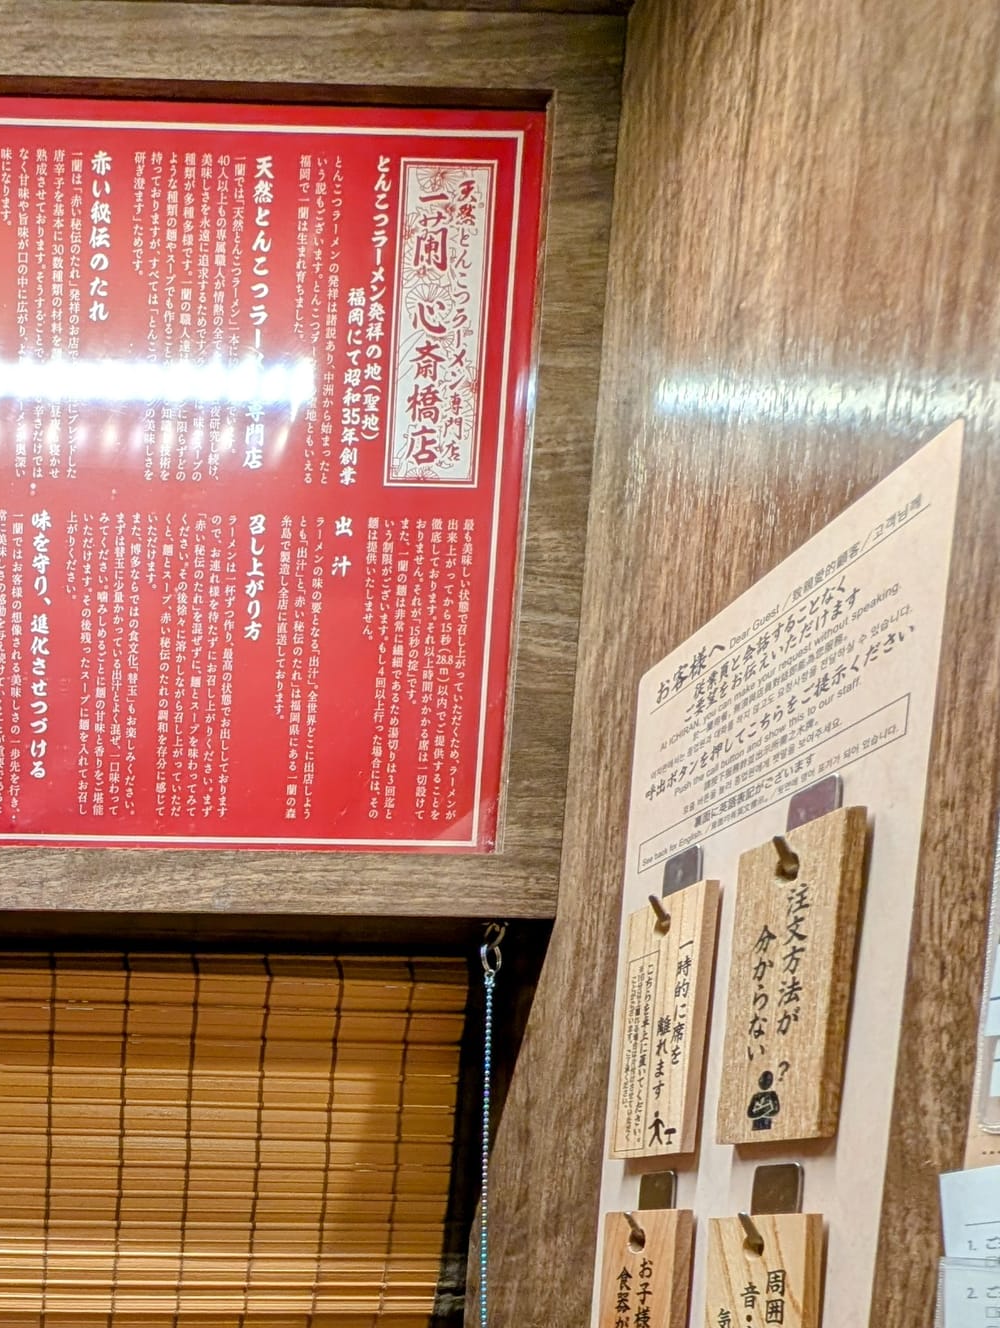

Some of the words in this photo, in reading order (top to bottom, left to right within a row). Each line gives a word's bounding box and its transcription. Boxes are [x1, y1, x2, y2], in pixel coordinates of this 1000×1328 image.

[0, 148, 13, 226] 味になります。
[89, 151, 112, 322] 赤い秘伝のたれ
[293, 155, 312, 342] 福岡で一蘭は生まれ育ちました。
[413, 193, 451, 271] 一蘭
[442, 180, 478, 463] 天然とんこつラーメン専門店
[339, 287, 366, 485] 福岡にて昭和35年創業
[66, 511, 78, 600] 上がりください。
[146, 513, 158, 590] いただけます。
[243, 514, 267, 641] 召し上がり方
[362, 517, 380, 640] 麺は提供いたしません。
[30, 510, 52, 779] 味を守り、進化させつづける
[274, 515, 293, 720] 糸島で製造し全店に直送しております。
[656, 644, 726, 704] お客様へ
[684, 588, 861, 723] ご要望をお伝えいただけます
[694, 575, 846, 699] 従業員と会話することなく
[704, 709, 717, 725] you
[718, 697, 732, 713] can
[734, 683, 756, 702] make
[758, 667, 777, 689] your
[778, 643, 812, 672] request
[813, 616, 849, 646] without
[851, 581, 902, 622] speaking.
[729, 626, 750, 650] Dear
[752, 604, 780, 631] Guest
[645, 624, 915, 802] 呼出ボタンを押してこちらをご提示ください
[674, 780, 692, 797] Push
[720, 748, 746, 772] button
[747, 739, 763, 754] and
[764, 724, 787, 744] show
[788, 710, 805, 728] this
[818, 694, 835, 710] our
[836, 676, 863, 699] staff.
[670, 939, 694, 1066] 一時的に席を
[746, 924, 778, 1063] 分からない
[776, 882, 815, 1036] 注文方法が
[652, 1015, 672, 1101] 離れます
